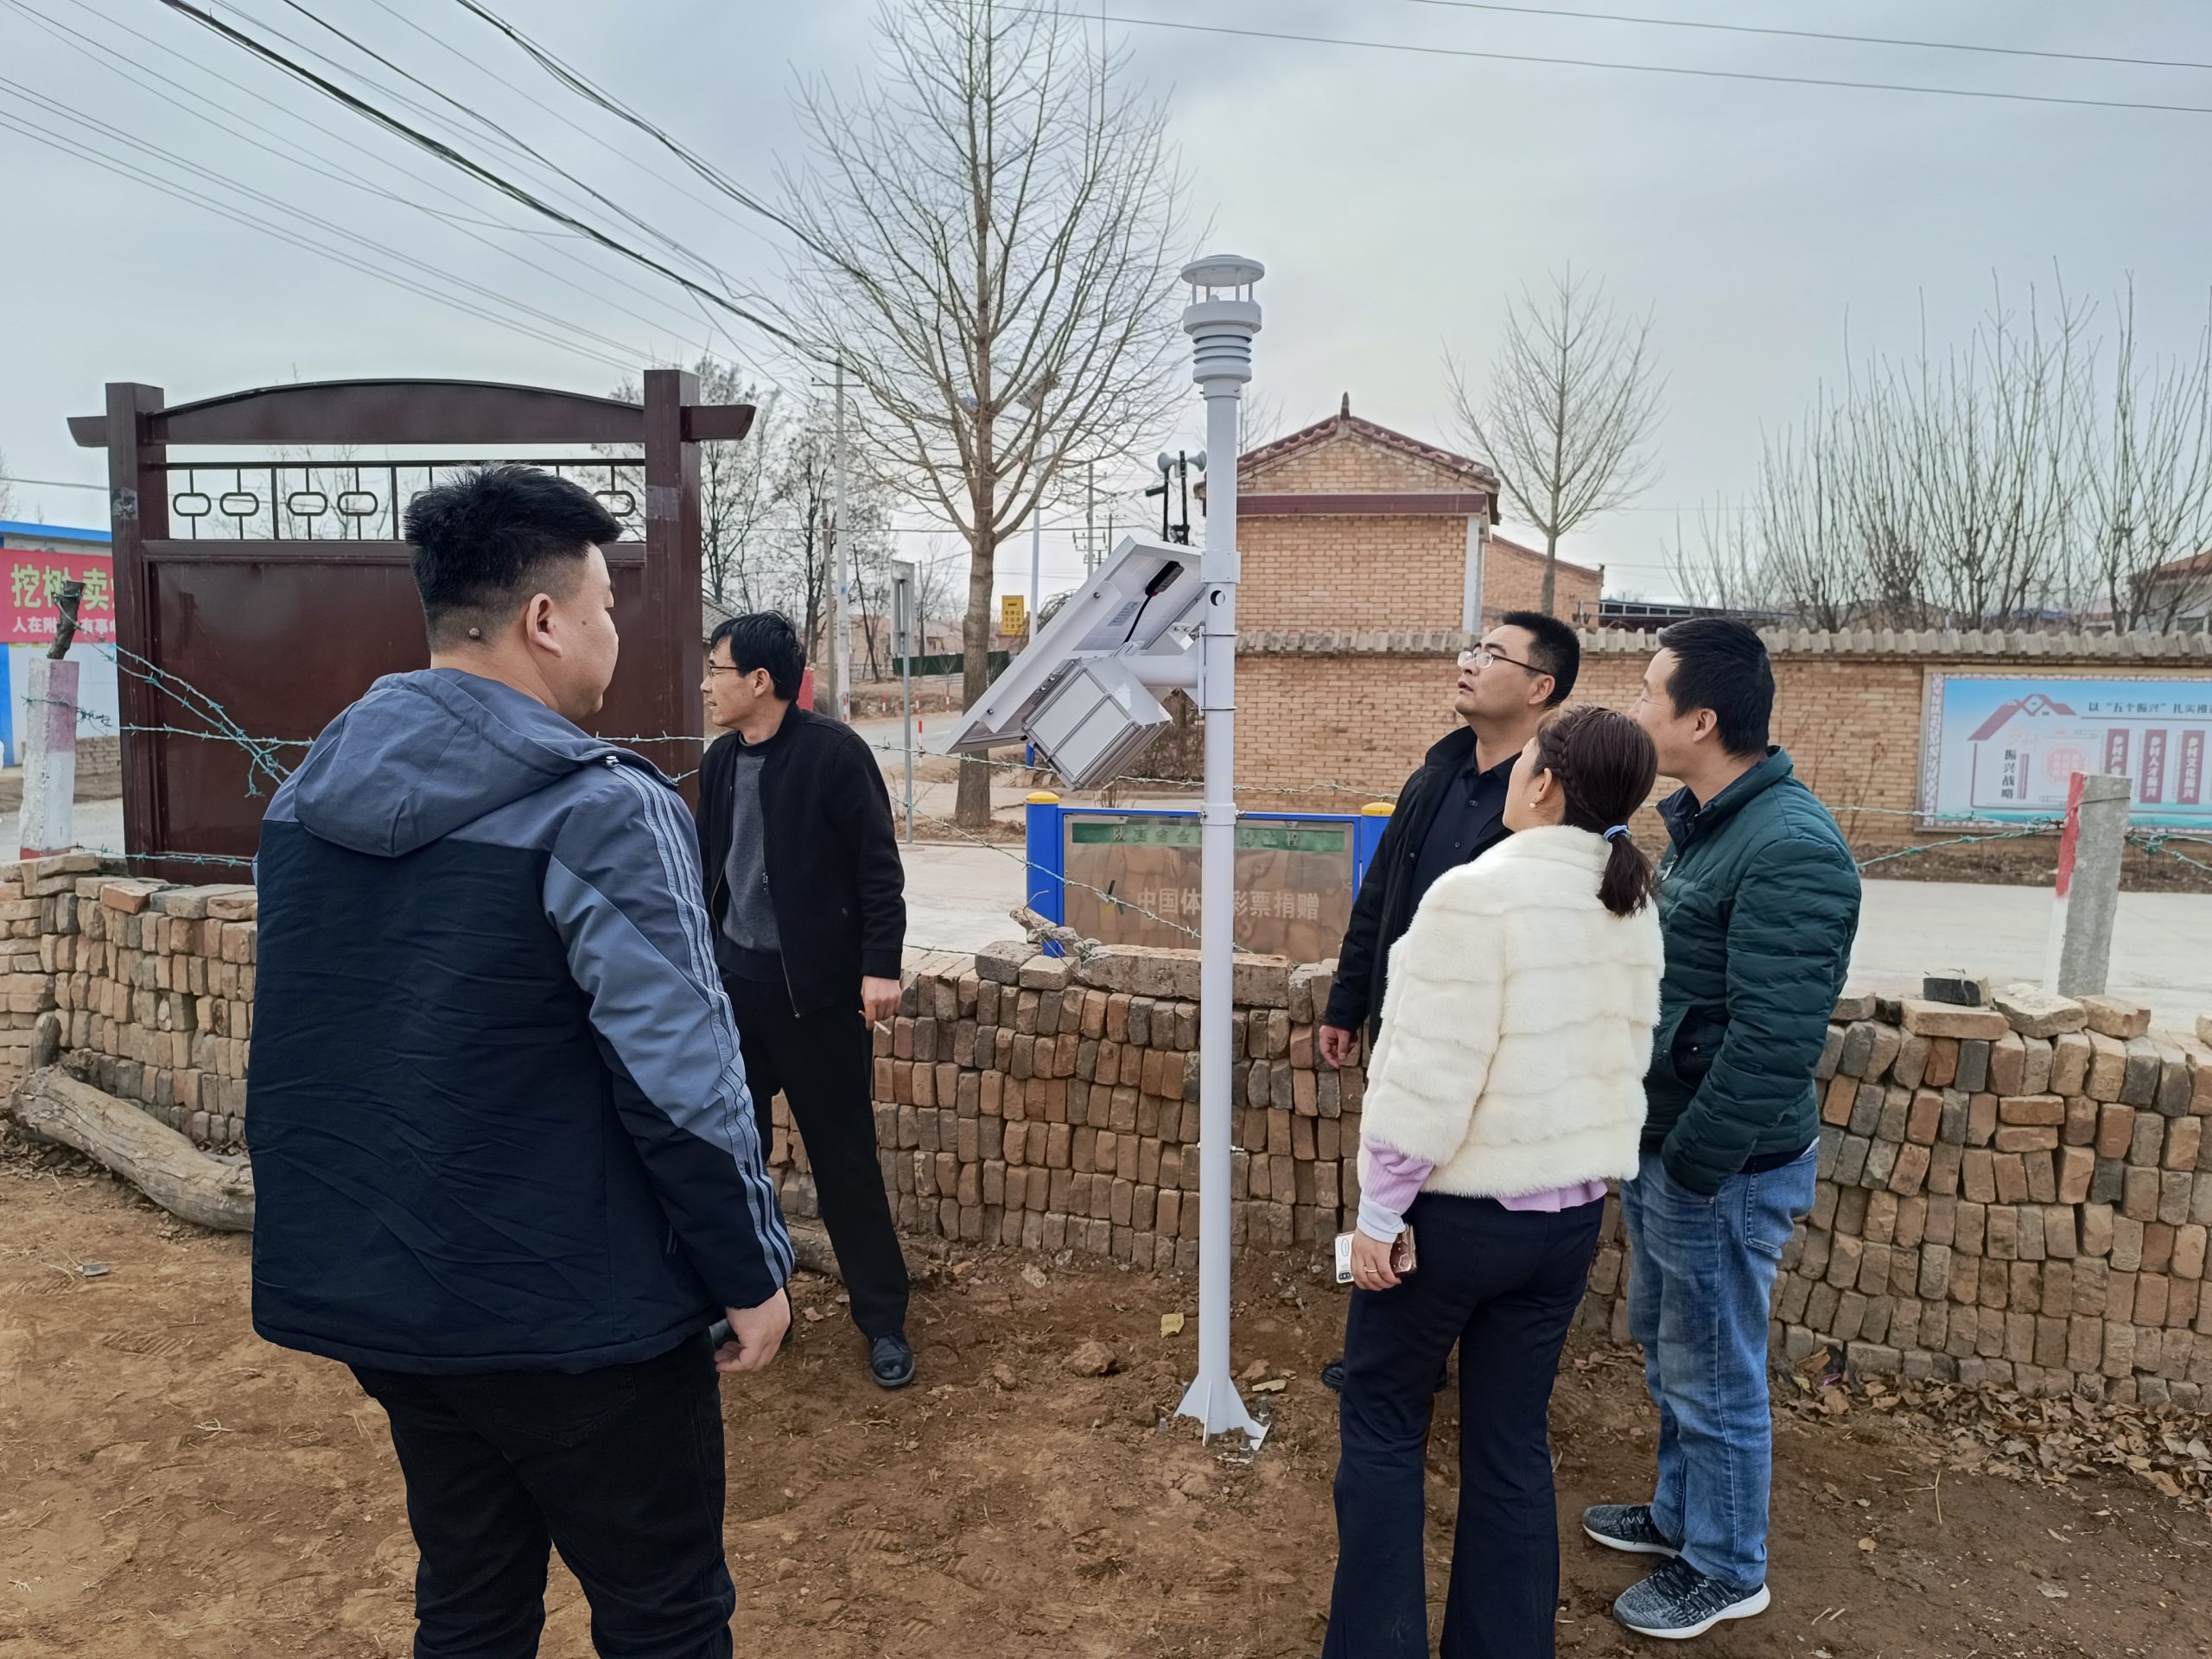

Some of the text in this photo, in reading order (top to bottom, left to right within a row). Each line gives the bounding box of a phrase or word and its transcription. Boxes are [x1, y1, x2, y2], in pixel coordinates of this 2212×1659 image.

[10, 563, 115, 612] 挖树卖
[12, 616, 116, 635] 人在附有事
[2001, 749, 2017, 799] 振兴战略
[2145, 735, 2161, 798] 乡村人才振兴
[2183, 736, 2199, 798] 乡村文化振兴
[1137, 887, 1320, 920] 中国体彩票捐赠
